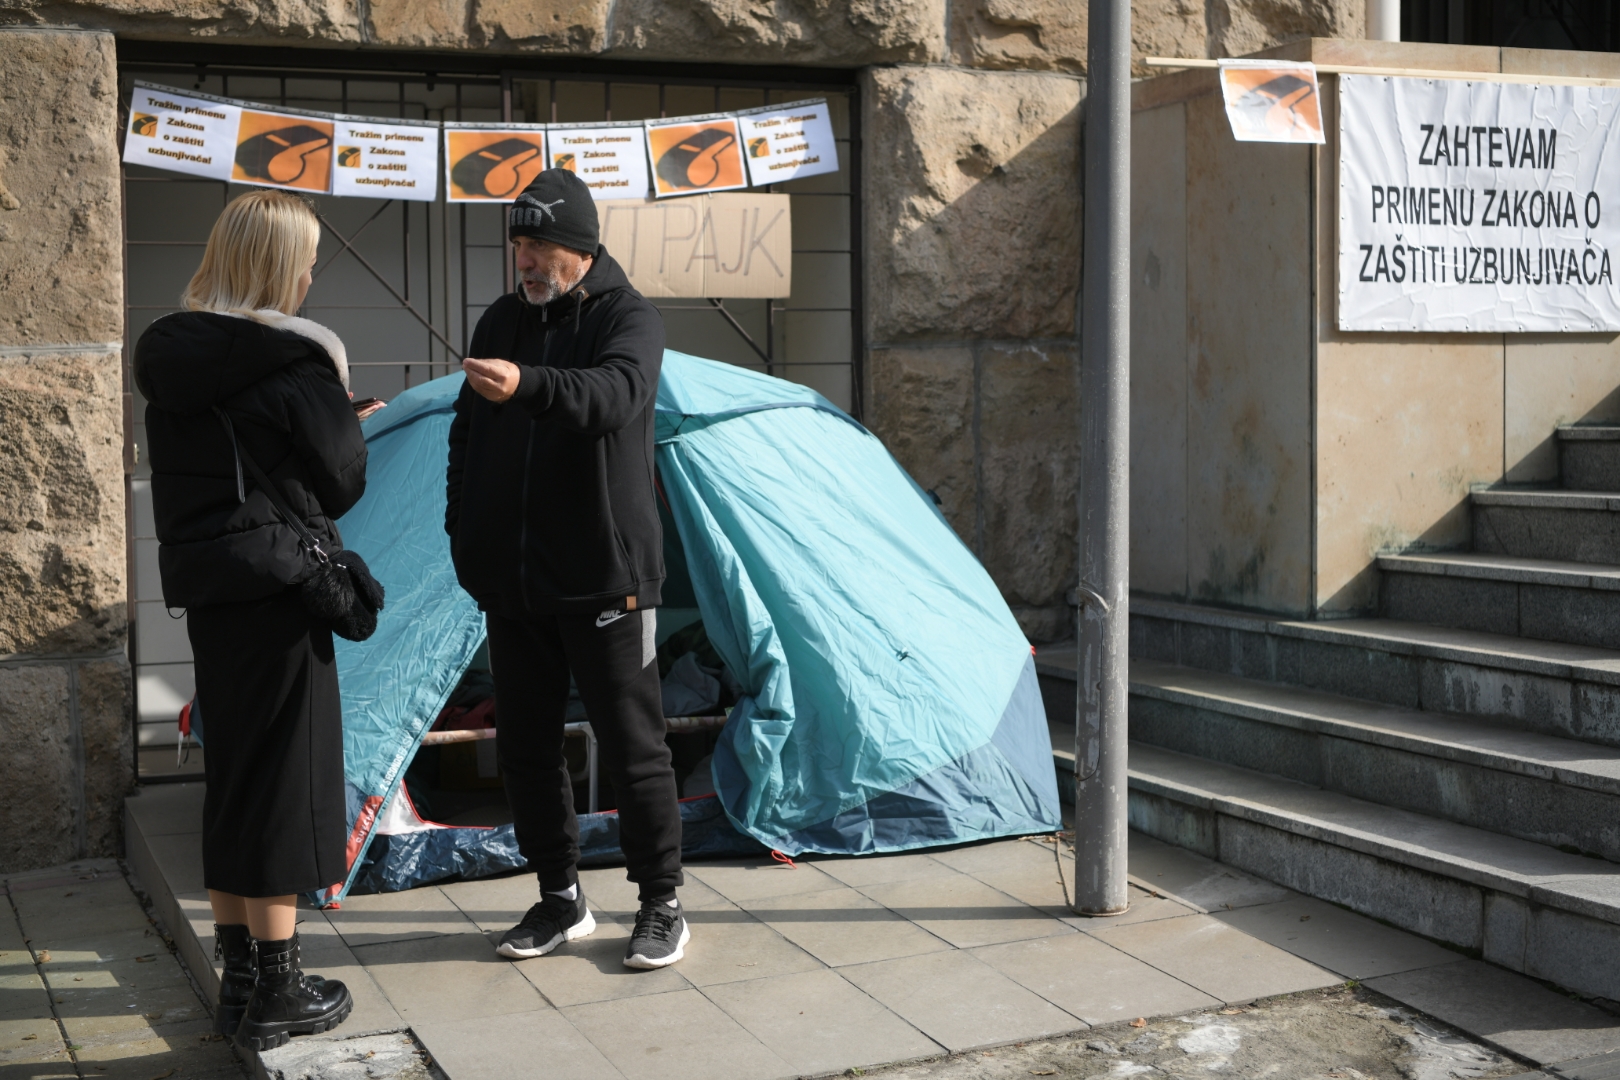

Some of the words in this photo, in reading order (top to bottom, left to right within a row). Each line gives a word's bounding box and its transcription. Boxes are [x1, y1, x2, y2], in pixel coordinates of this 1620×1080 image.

[147, 97, 182, 111] Tražim
[185, 106, 226, 119] primenu
[167, 117, 205, 131] Zakona
[172, 135, 204, 147] zaštiti
[348, 129, 382, 139] Tražim
[385, 133, 424, 142] primenu
[562, 136, 592, 144] Tražim
[596, 136, 631, 145] primenu
[369, 146, 406, 156] Zakona
[1418, 123, 1557, 170] ZAHTEVAM
[583, 151, 616, 159] Zakona
[377, 163, 407, 171] zaštiti
[592, 165, 619, 173] zaštiti
[587, 179, 629, 189] unjivača!
[1372, 184, 1475, 227] PRIMENU
[1481, 188, 1578, 229] ZAKONA
[1584, 191, 1601, 229] O
[1359, 234, 1446, 285] ZAŠTITI
[1454, 237, 1614, 285] UZBUNJIVAČA
[384, 754, 404, 787] SECONDS
